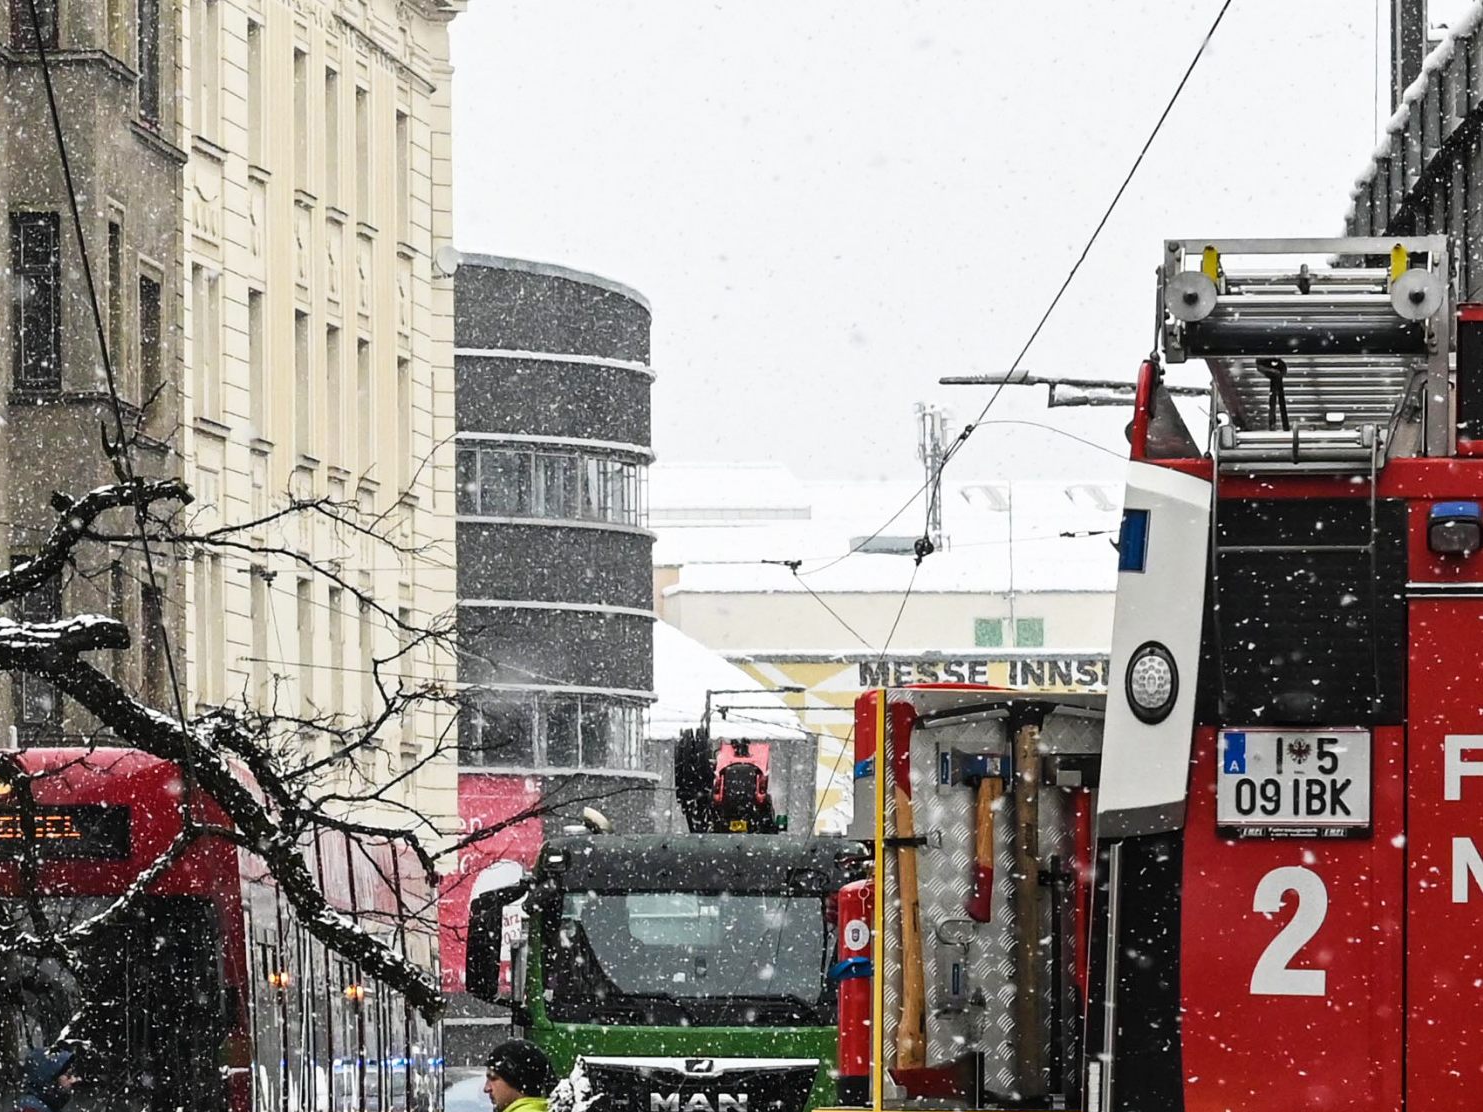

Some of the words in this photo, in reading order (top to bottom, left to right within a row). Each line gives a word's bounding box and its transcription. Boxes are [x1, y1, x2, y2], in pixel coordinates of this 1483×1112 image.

[859, 659, 989, 687] MESSE
[1229, 760, 1240, 772] A
[1317, 738, 1339, 775] 5
[1444, 734, 1483, 801] F
[1235, 778, 1281, 816] 09
[1293, 778, 1352, 816] IBK
[1452, 836, 1483, 904] N
[1249, 866, 1328, 997] 2
